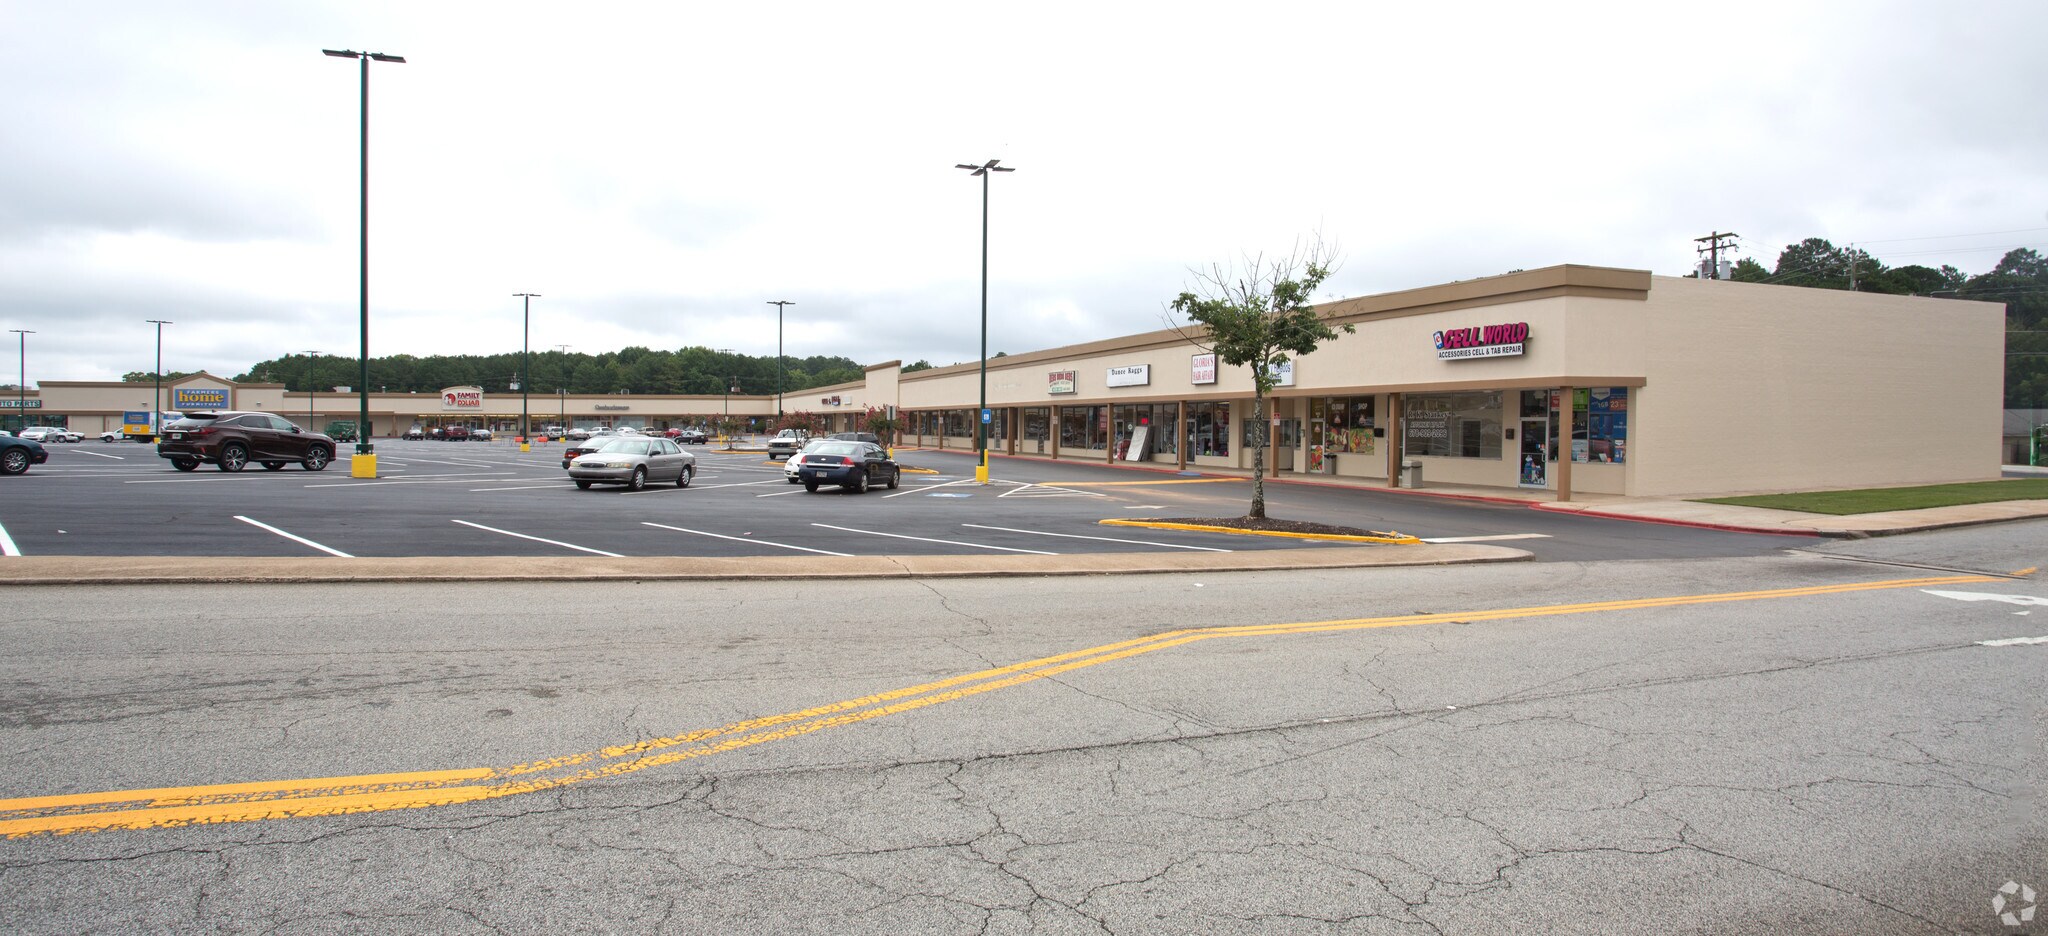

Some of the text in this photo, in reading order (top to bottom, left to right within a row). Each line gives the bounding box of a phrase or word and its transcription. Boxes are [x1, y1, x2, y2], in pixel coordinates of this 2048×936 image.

[1443, 322, 1529, 349] CELL WORLD
[1438, 345, 1522, 359] ACCESSORIES CELL & TAB REPAIR
[178, 390, 225, 403] home
